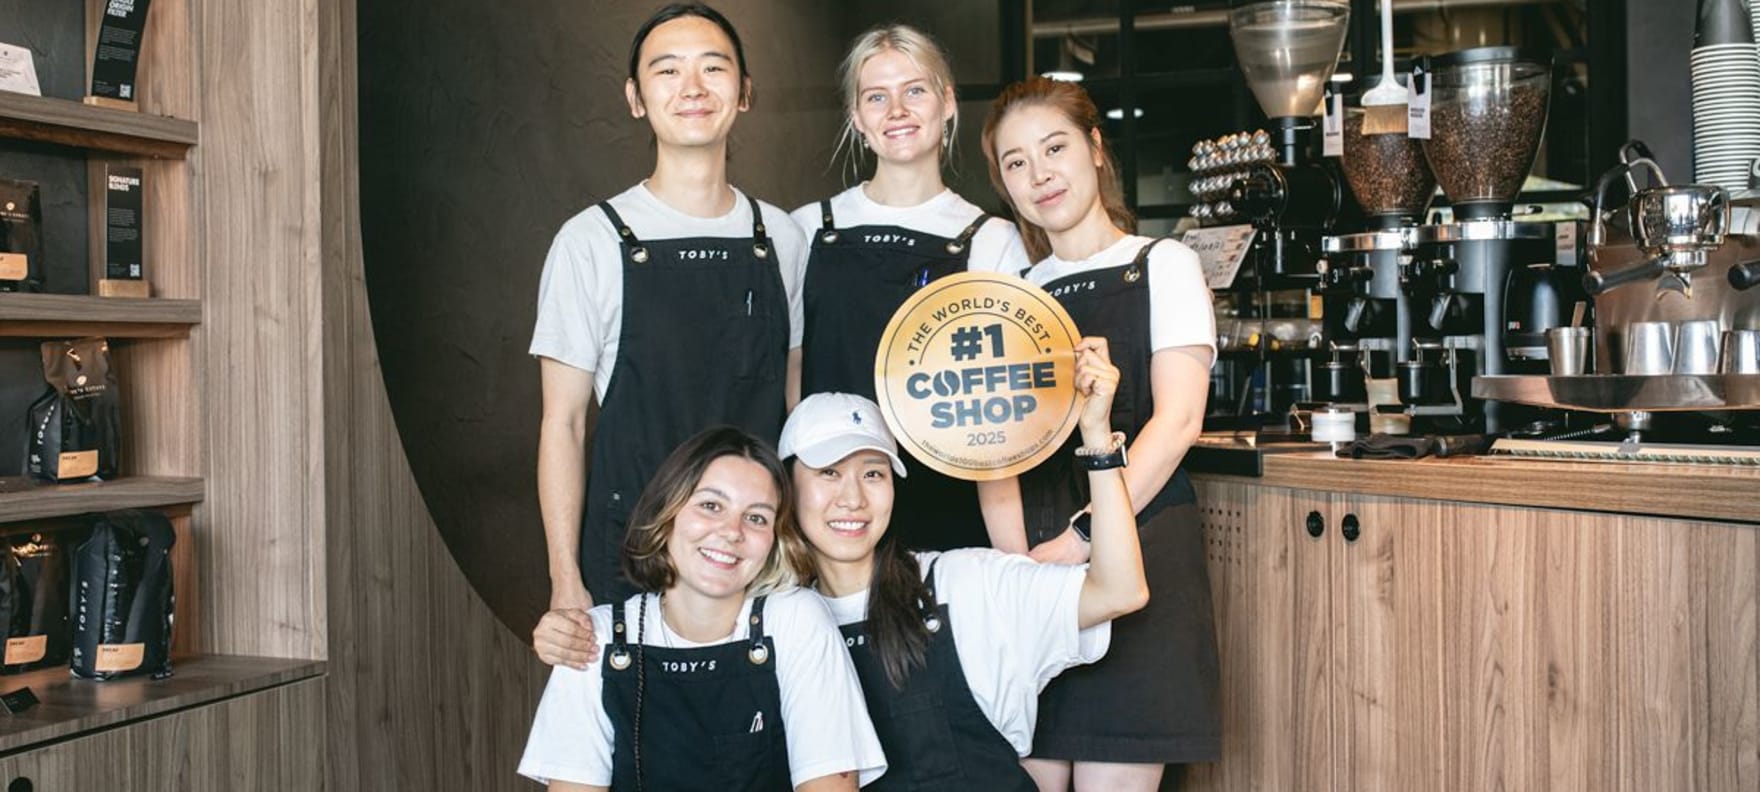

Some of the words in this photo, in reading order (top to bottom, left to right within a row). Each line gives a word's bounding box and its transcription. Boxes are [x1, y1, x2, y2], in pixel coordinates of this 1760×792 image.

[678, 249, 728, 260] TOBY'S
[864, 234, 916, 247] TOBY'S
[907, 322, 933, 352] THE
[932, 297, 1011, 322] WORLD'S
[1014, 308, 1051, 342] BEST
[951, 323, 1005, 362] #1
[906, 361, 1057, 400] COFFEE
[930, 394, 1038, 429] SHOP
[966, 431, 1007, 447] 2025
[79, 581, 88, 631] TOBY'S
[662, 660, 717, 672] TOBY'S
